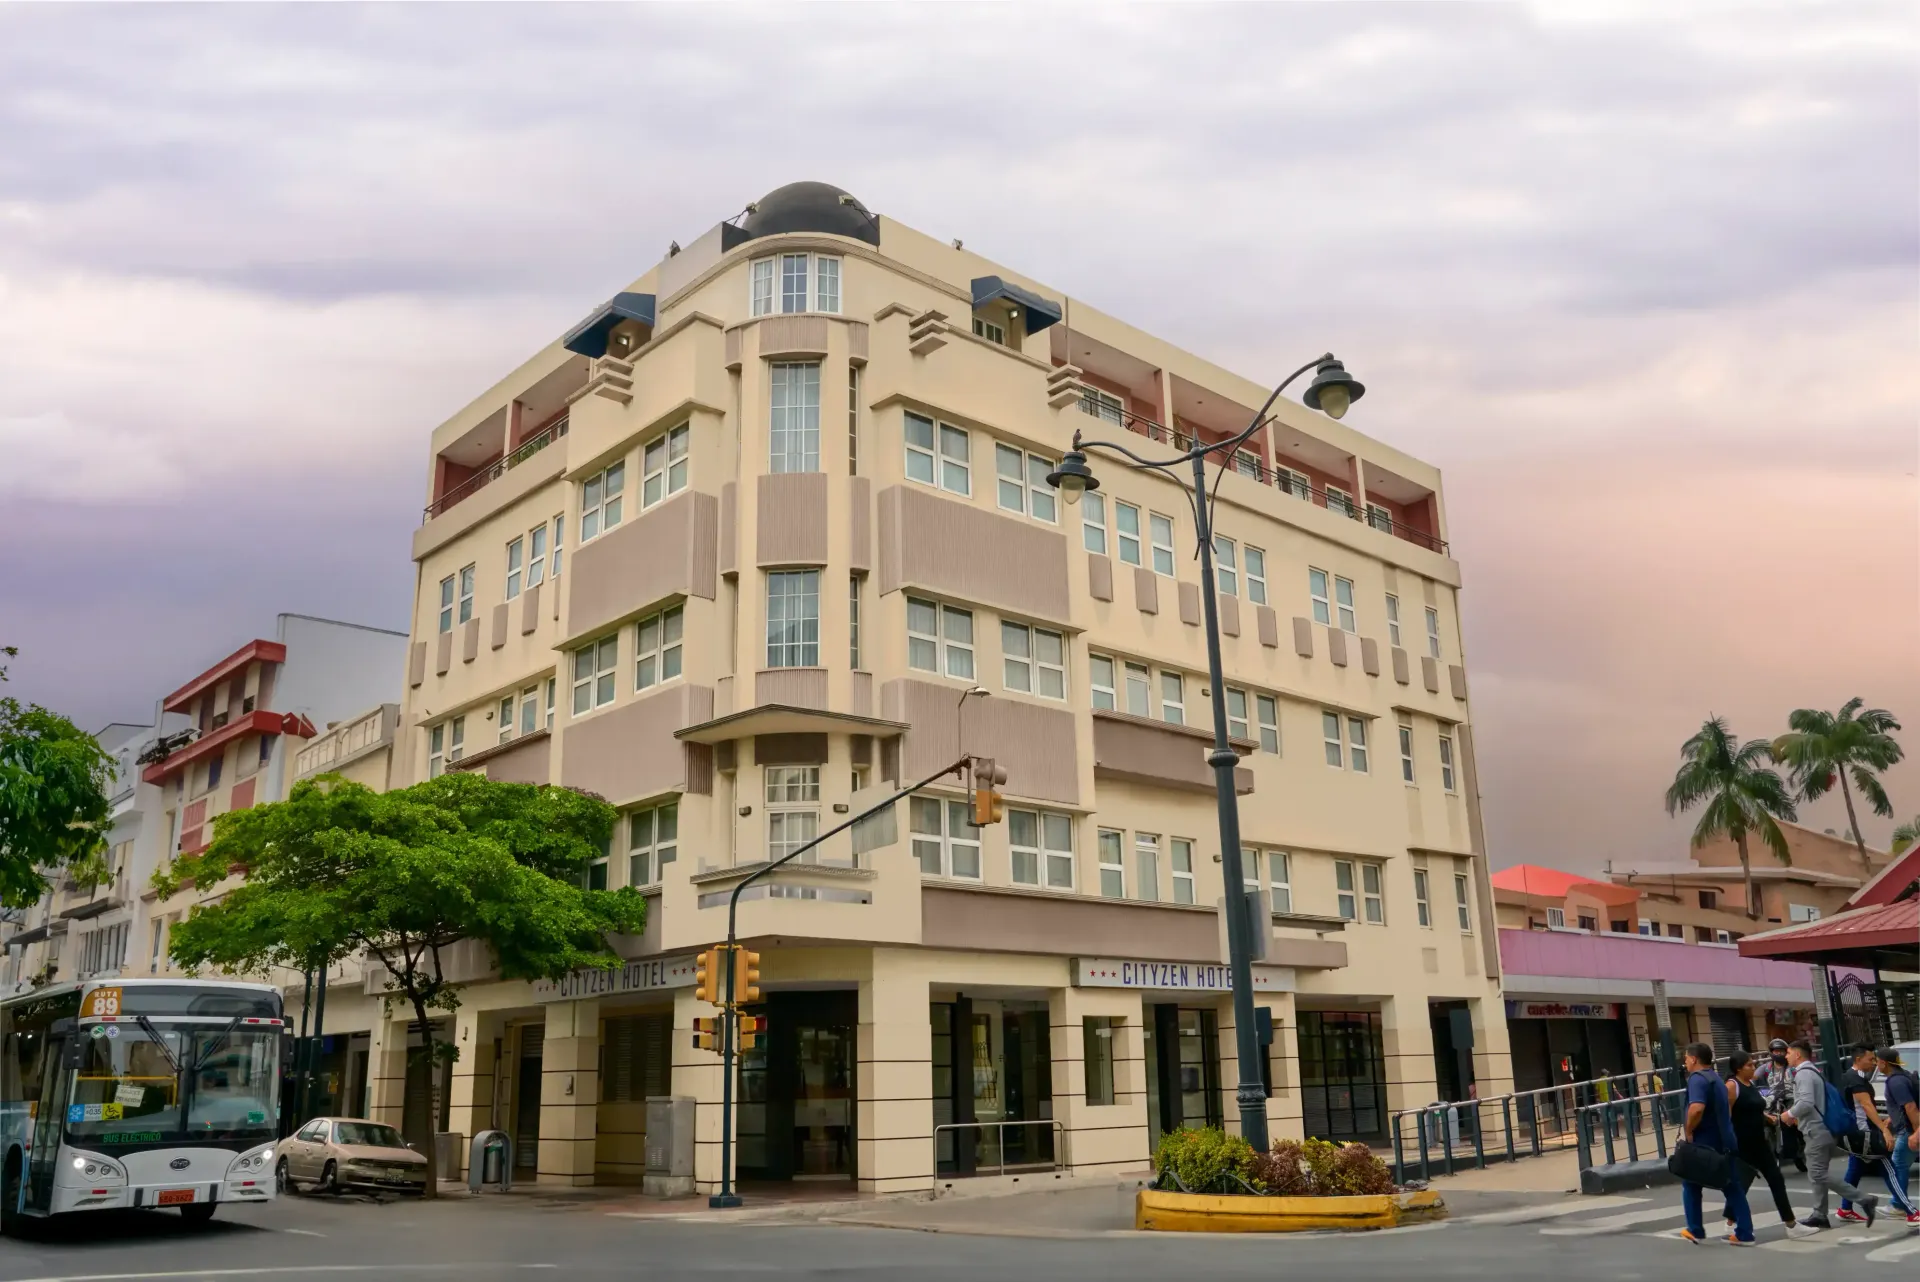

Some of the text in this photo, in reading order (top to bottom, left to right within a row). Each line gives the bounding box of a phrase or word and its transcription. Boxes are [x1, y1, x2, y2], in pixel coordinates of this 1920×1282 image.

[560, 961, 666, 996] CITYZEN HOTEL
[1123, 963, 1233, 988] CITYZEN HOTE
[93, 997, 118, 1015] 89
[103, 1133, 120, 1143] BUS
